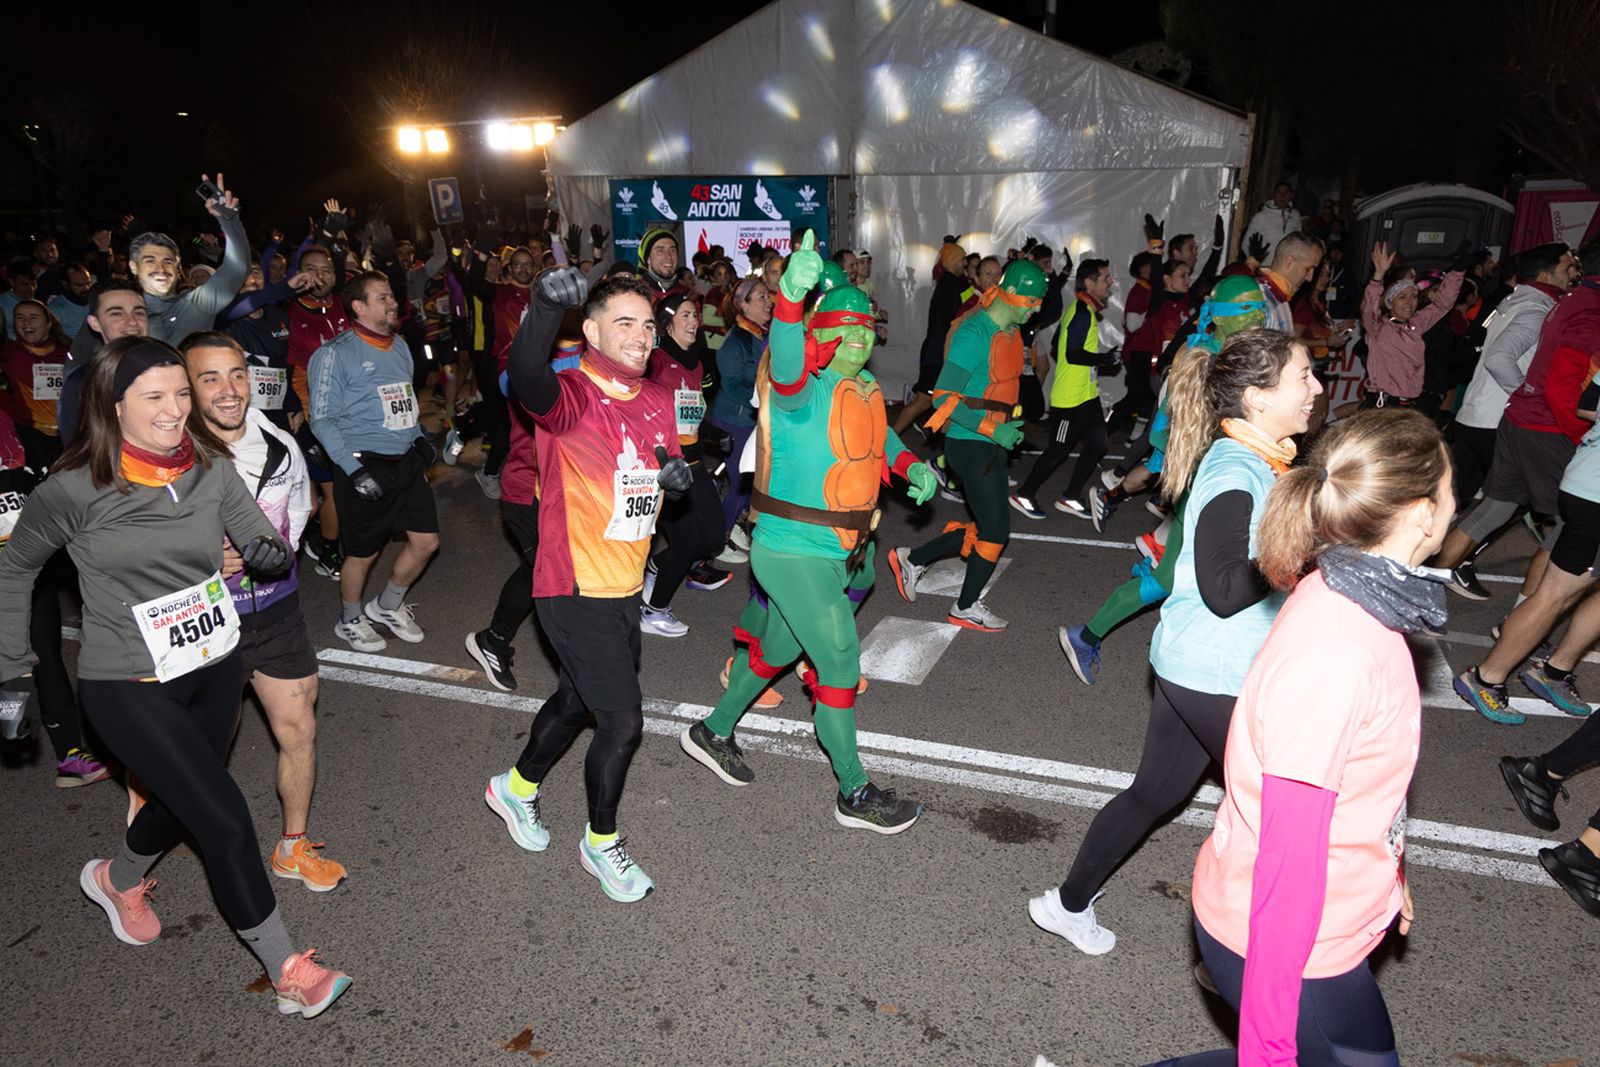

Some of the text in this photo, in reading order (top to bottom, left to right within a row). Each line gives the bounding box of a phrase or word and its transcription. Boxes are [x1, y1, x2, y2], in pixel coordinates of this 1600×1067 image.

[436, 184, 454, 208] P
[691, 184, 743, 202] 43 SAN
[687, 198, 741, 217] ANTÓN
[258, 382, 282, 395] 3961
[391, 398, 413, 415] 6418
[679, 405, 703, 420] 13352
[160, 599, 191, 615] NOCHE
[192, 592, 203, 604] DE
[152, 615, 174, 630] SAN
[169, 604, 226, 648] 4504
[1479, 689, 1499, 711] HOKA
